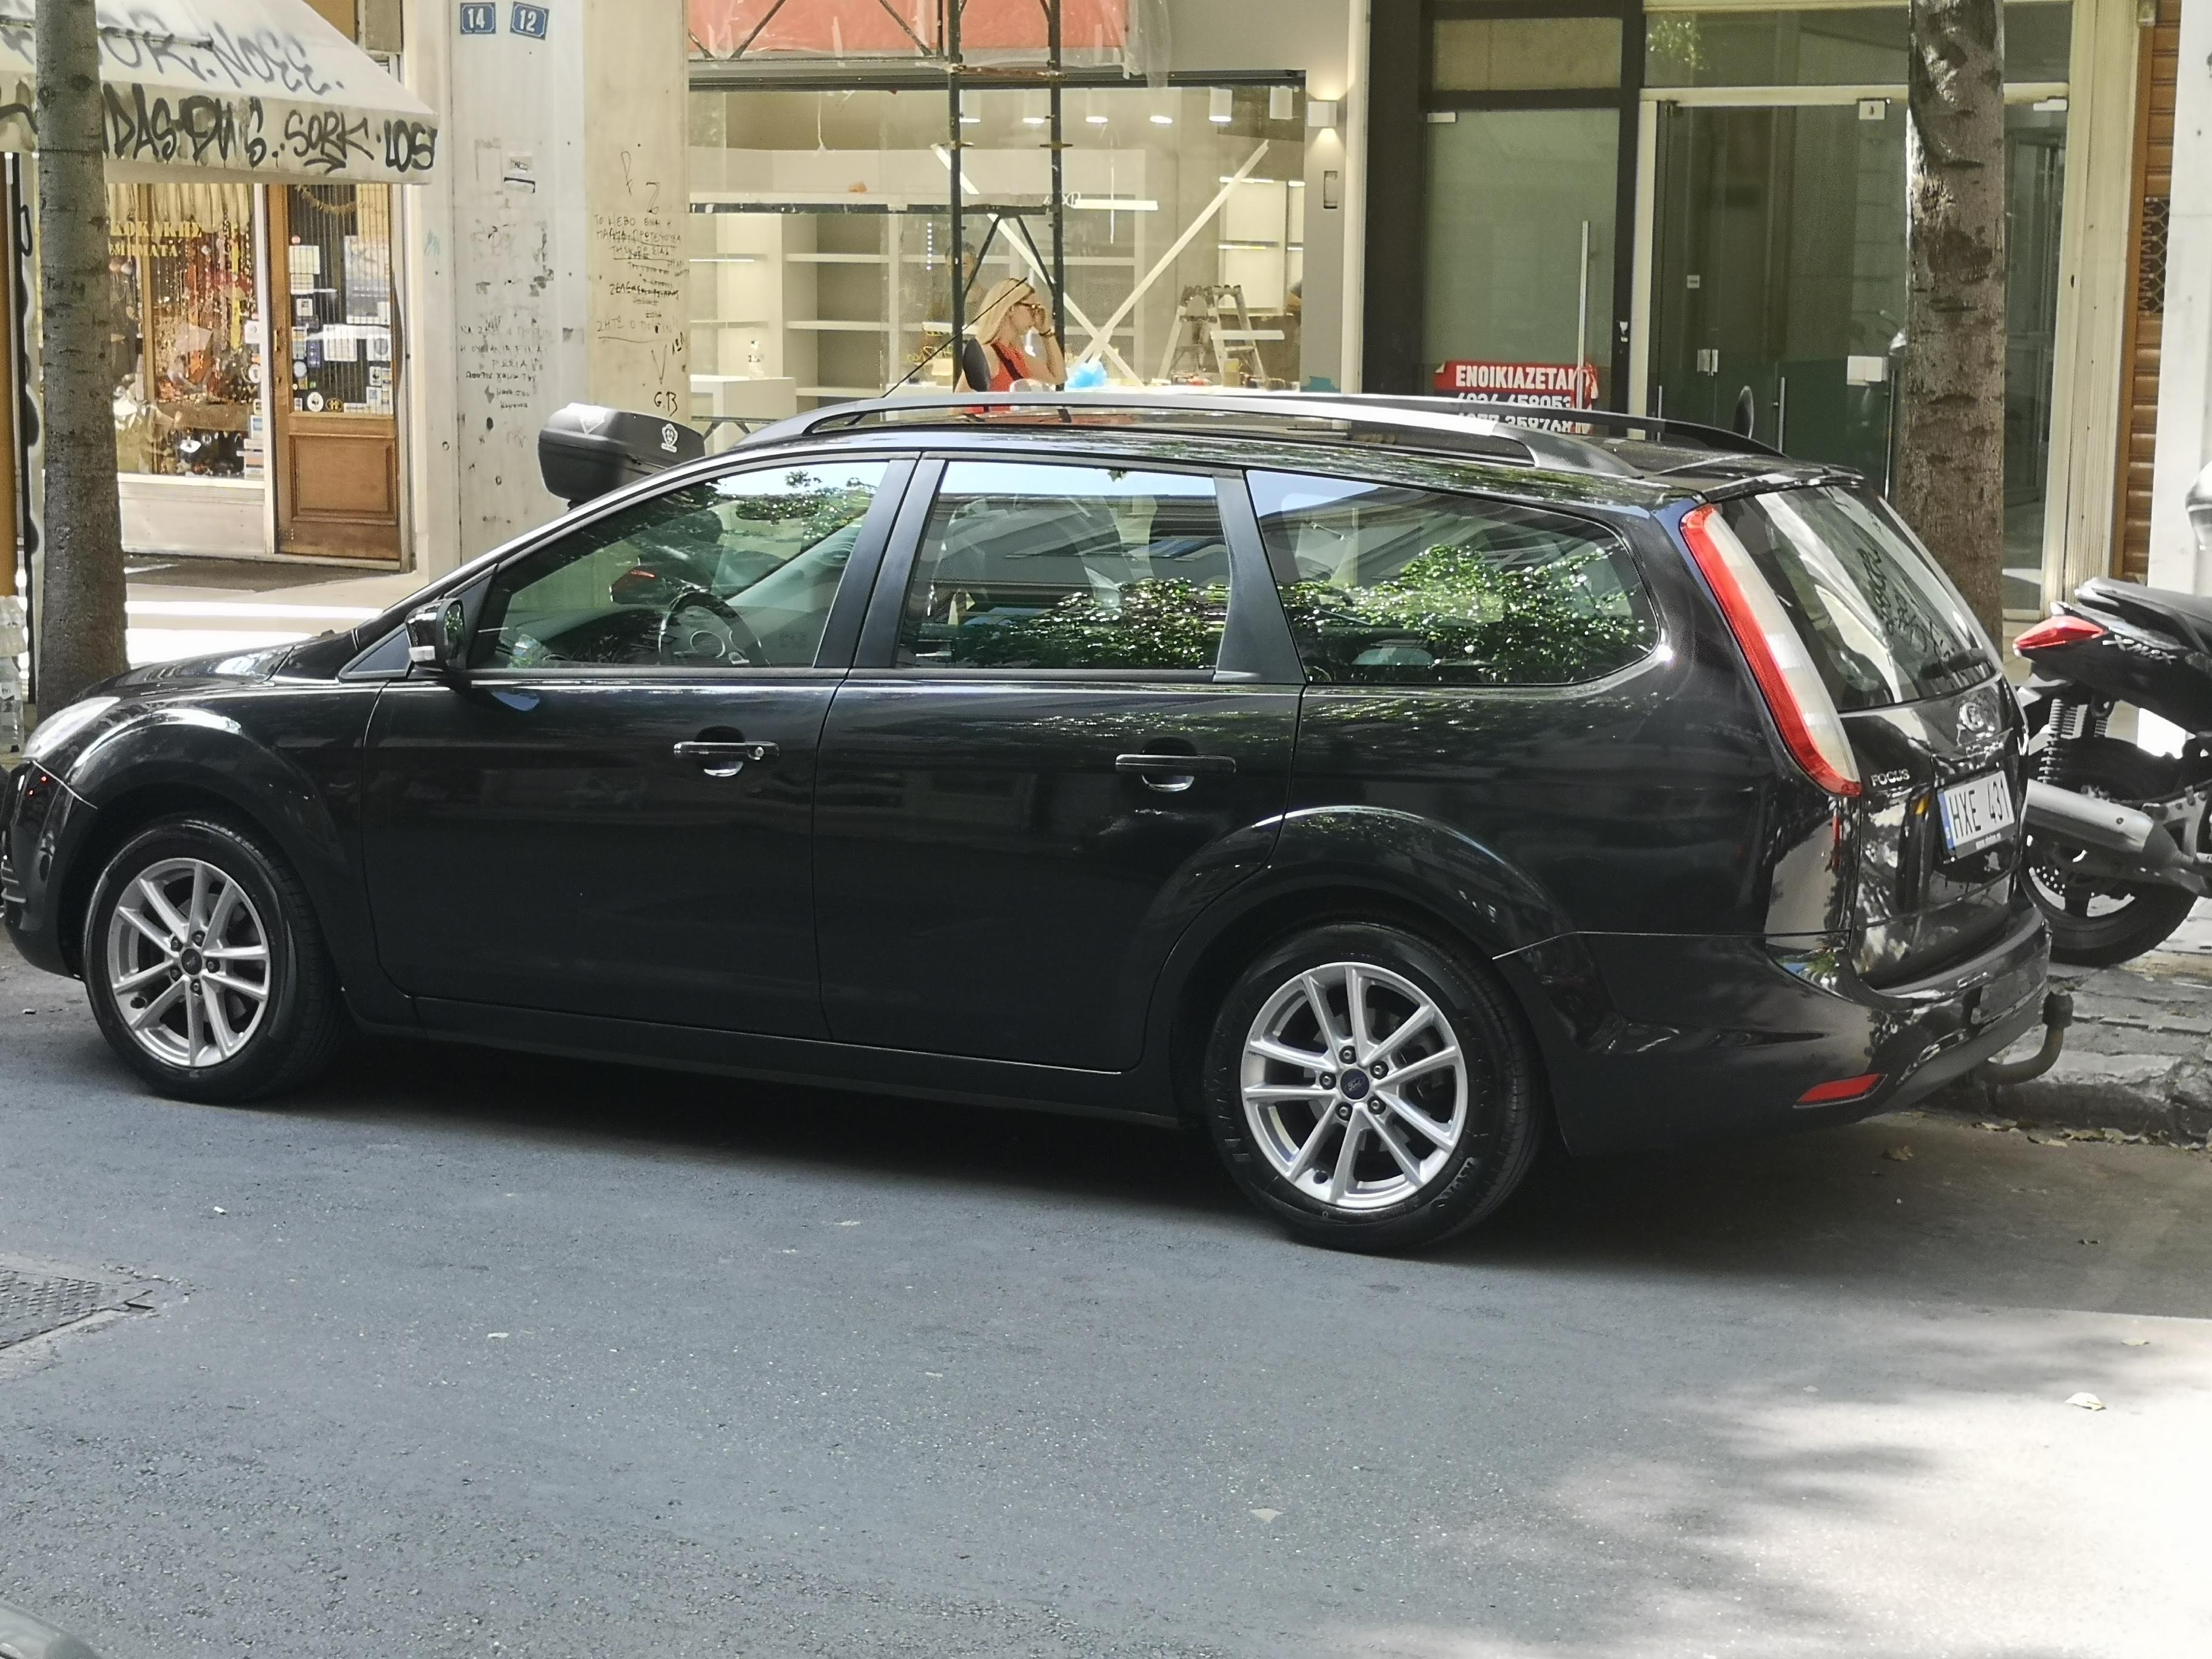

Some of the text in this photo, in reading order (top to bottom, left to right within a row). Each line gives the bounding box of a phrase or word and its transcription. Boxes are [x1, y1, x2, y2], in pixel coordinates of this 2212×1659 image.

[468, 8, 486, 29] 14
[519, 10, 536, 32] 12
[1871, 769, 1910, 786] FOCUS
[1948, 778, 2010, 839] HXE 431
